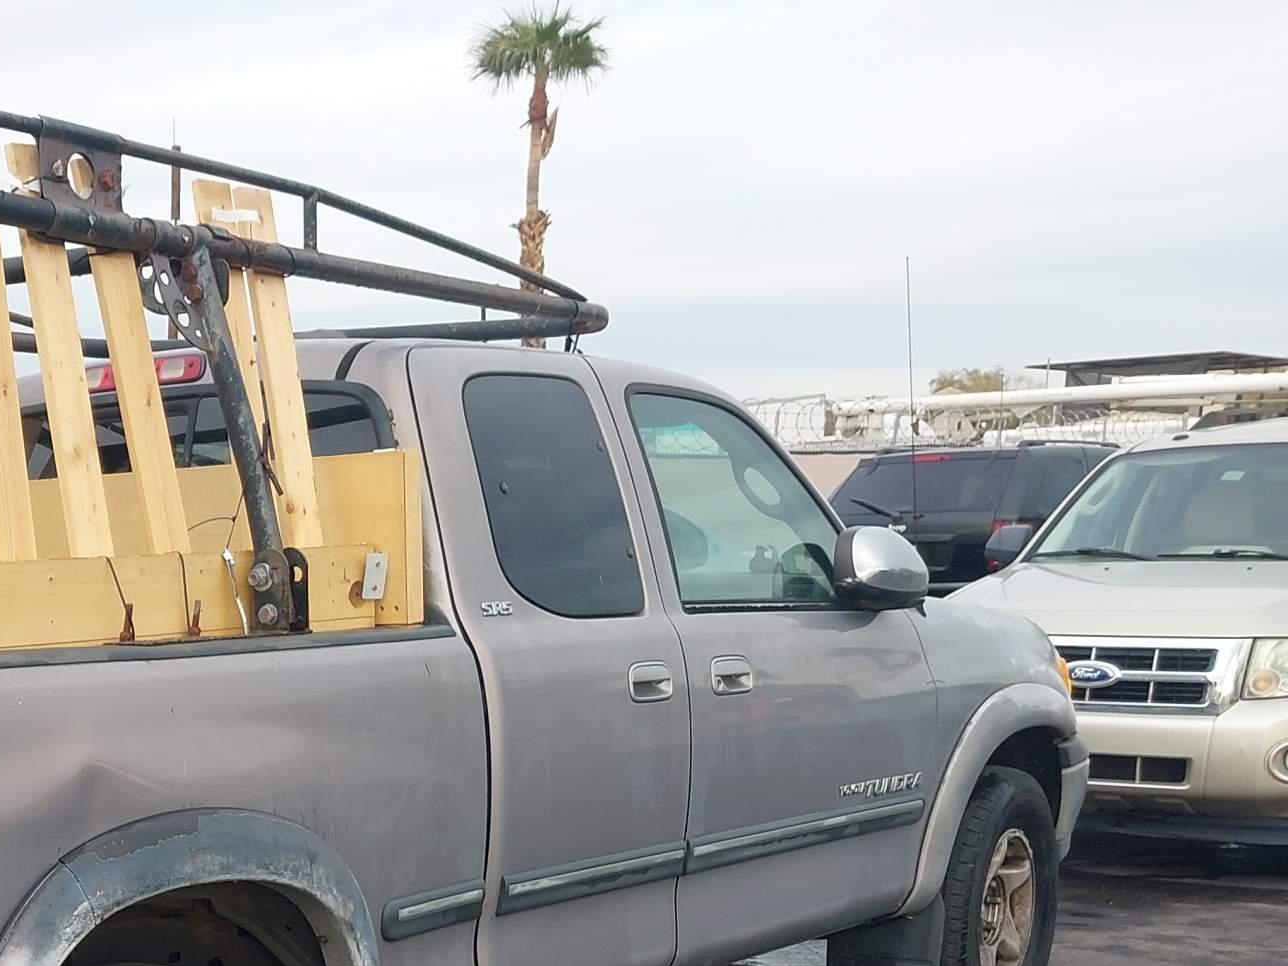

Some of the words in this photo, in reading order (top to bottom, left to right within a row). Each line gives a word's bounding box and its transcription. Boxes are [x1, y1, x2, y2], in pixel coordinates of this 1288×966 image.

[480, 601, 513, 616] SR5
[1071, 666, 1101, 679] Ford
[865, 771, 923, 797] TUNDRA
